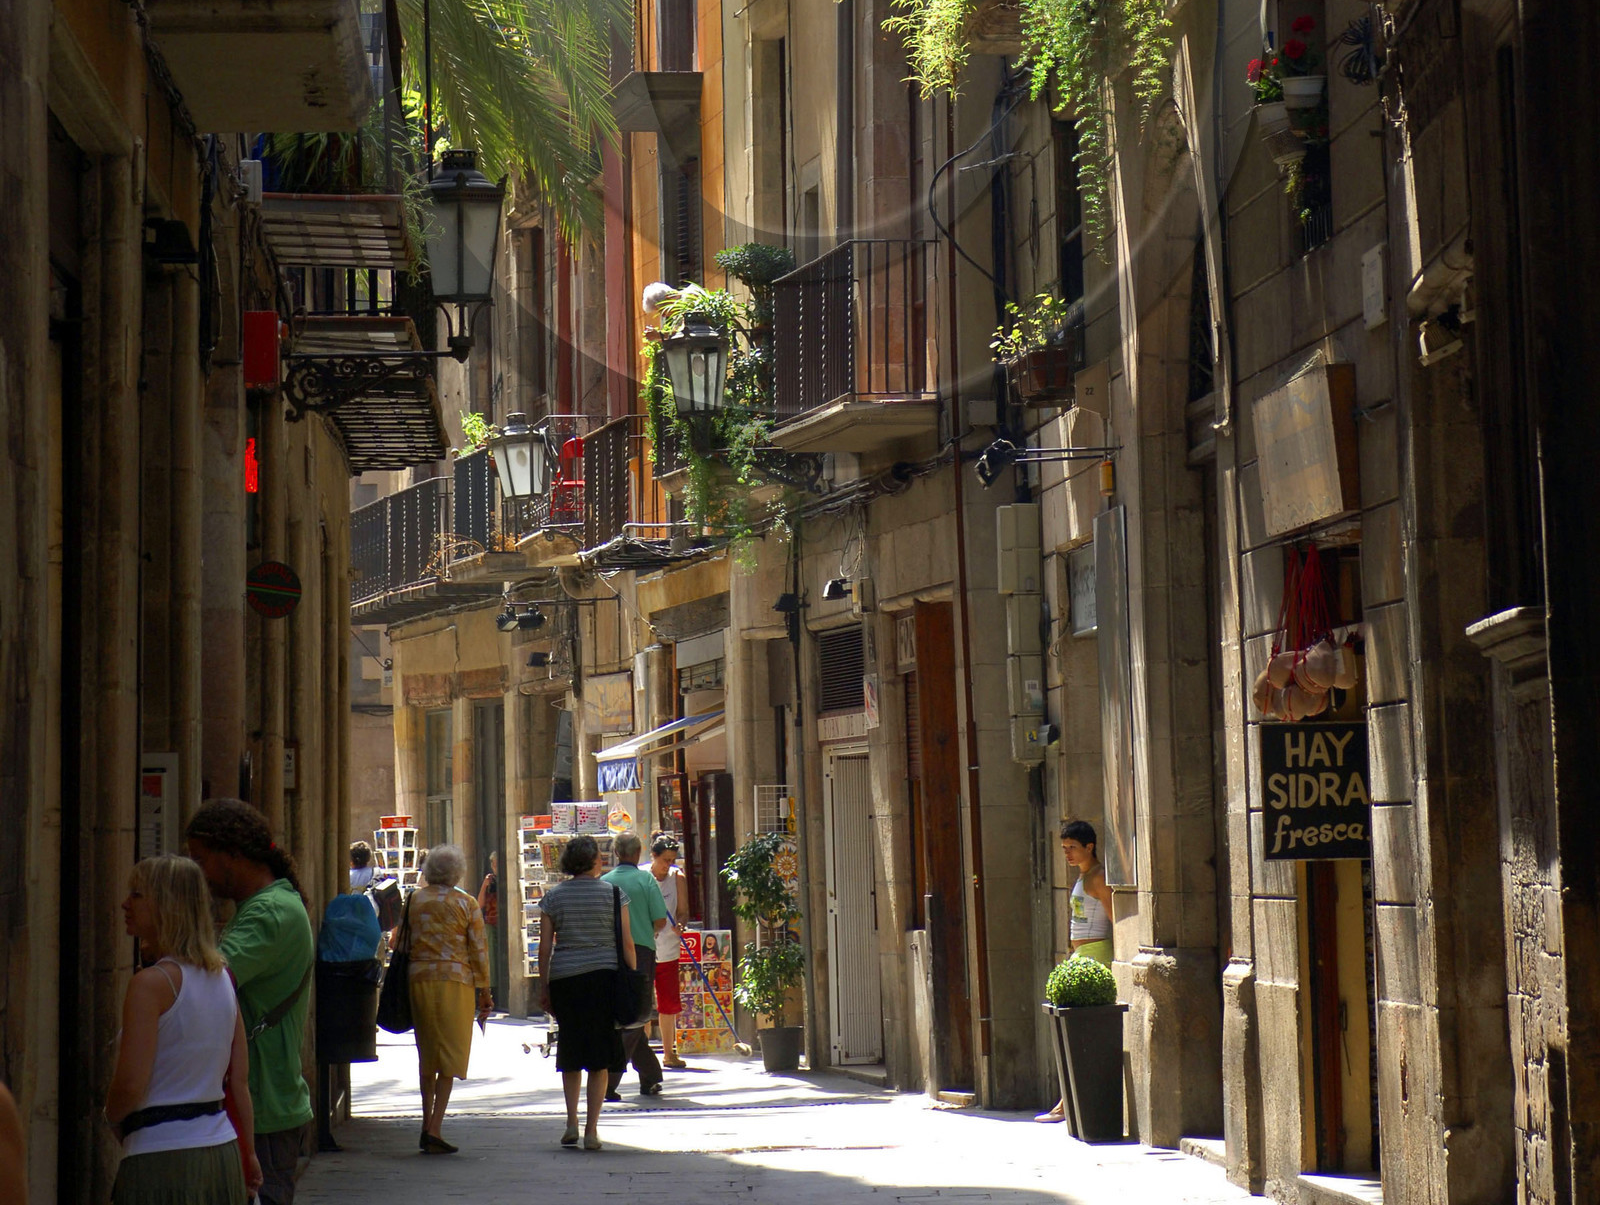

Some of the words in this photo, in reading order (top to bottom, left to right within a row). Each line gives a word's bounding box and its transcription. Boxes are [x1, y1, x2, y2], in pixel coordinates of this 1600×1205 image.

[1085, 387, 1095, 396] 22
[1284, 731, 1354, 768] HAY
[1268, 772, 1369, 810] SIDRA
